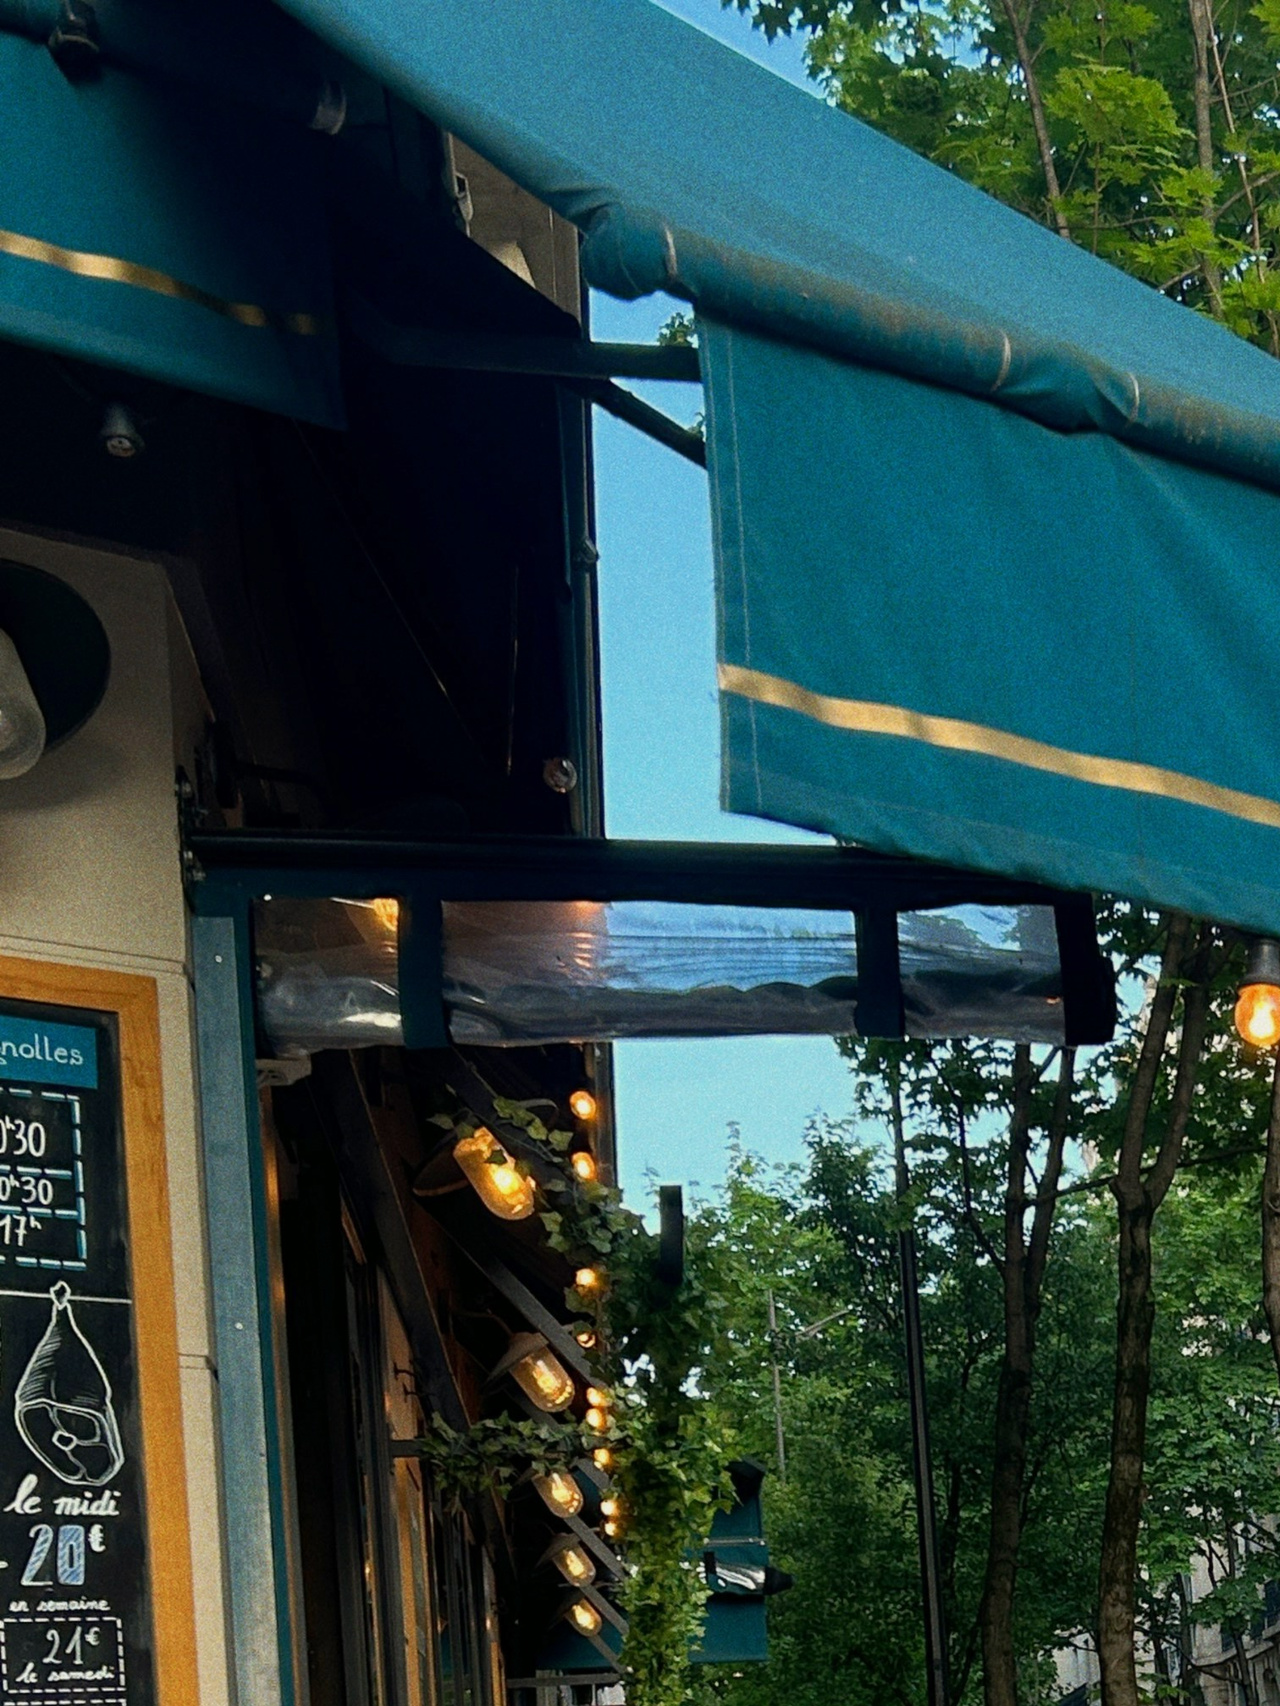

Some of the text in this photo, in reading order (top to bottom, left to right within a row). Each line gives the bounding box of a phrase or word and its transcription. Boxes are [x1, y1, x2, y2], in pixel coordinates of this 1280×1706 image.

[0, 1033, 83, 1067] nolles
[4, 1474, 121, 1516] le midi
[21, 1523, 106, 1586] 20€
[37, 1597, 111, 1612] semaine
[42, 1626, 100, 1665] 21€
[16, 1662, 115, 1683] le samedi
